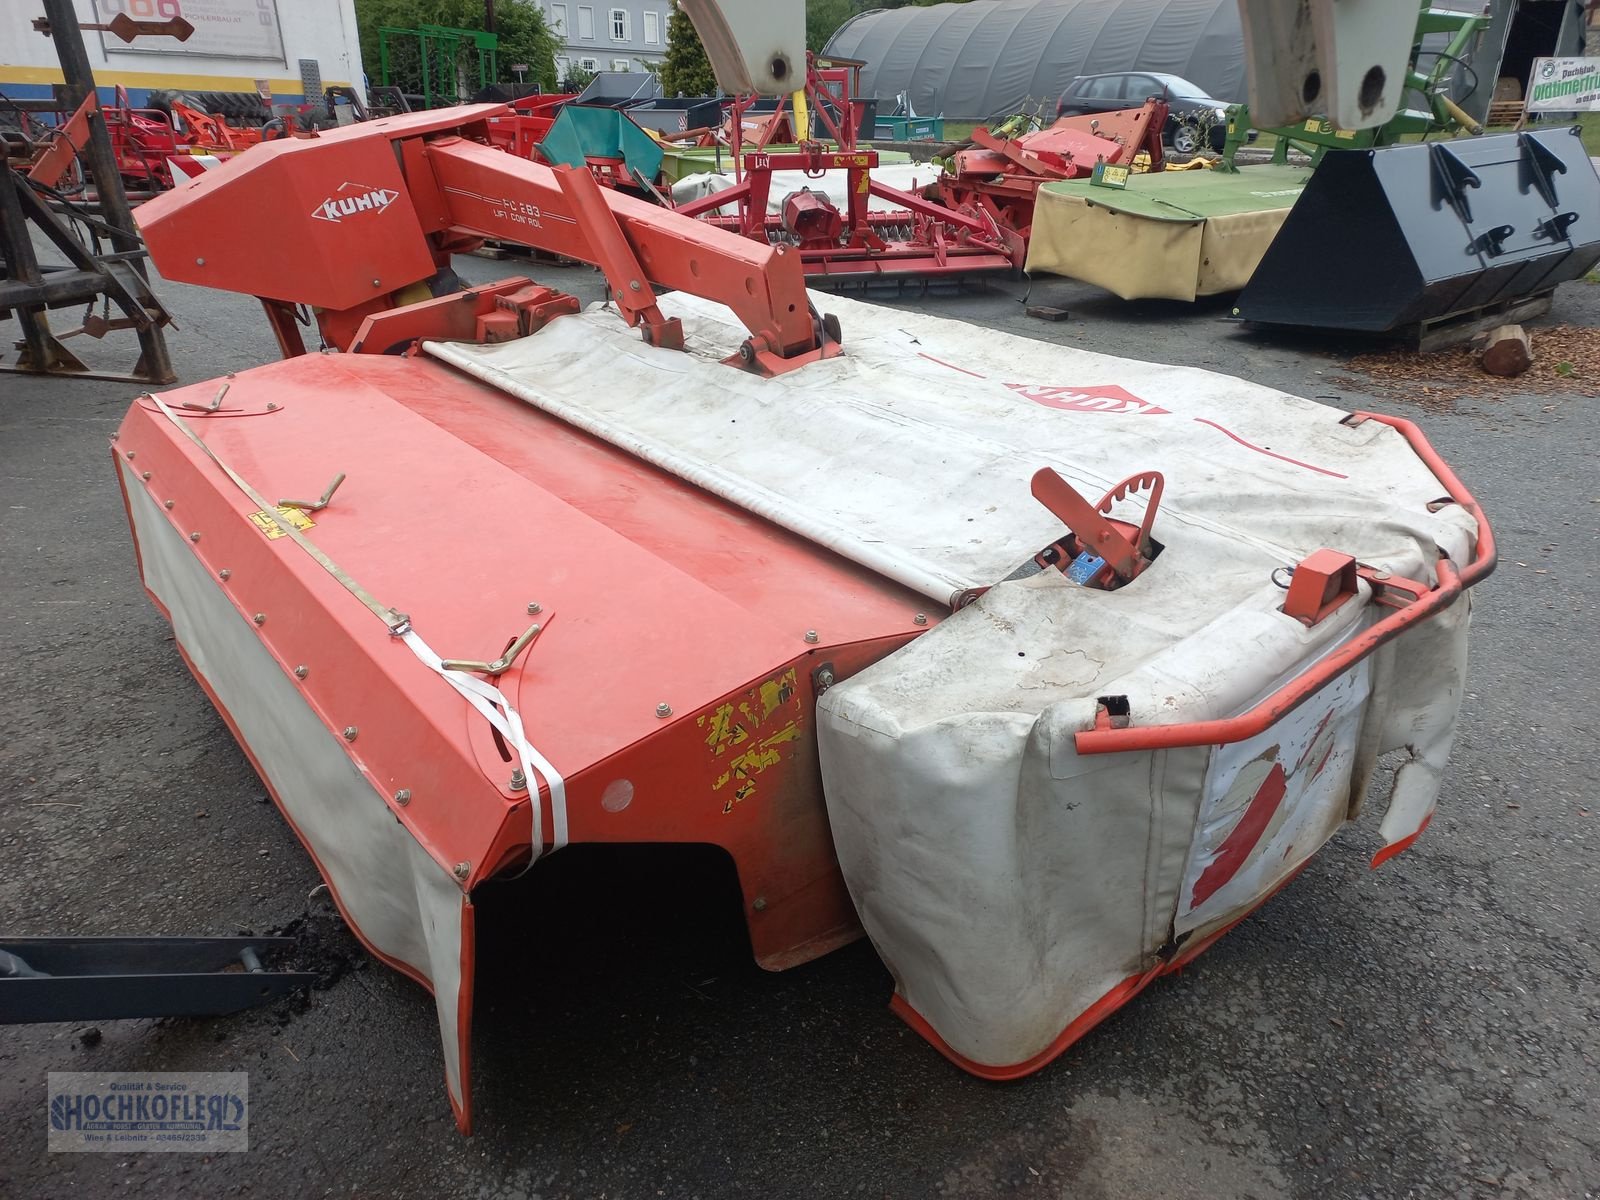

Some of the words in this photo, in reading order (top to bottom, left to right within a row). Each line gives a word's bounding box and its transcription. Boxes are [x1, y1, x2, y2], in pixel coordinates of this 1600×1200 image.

[755, 156, 770, 169] LELY
[323, 189, 389, 219] KUHN
[519, 202, 541, 217] 283
[1008, 385, 1160, 414] KUHN
